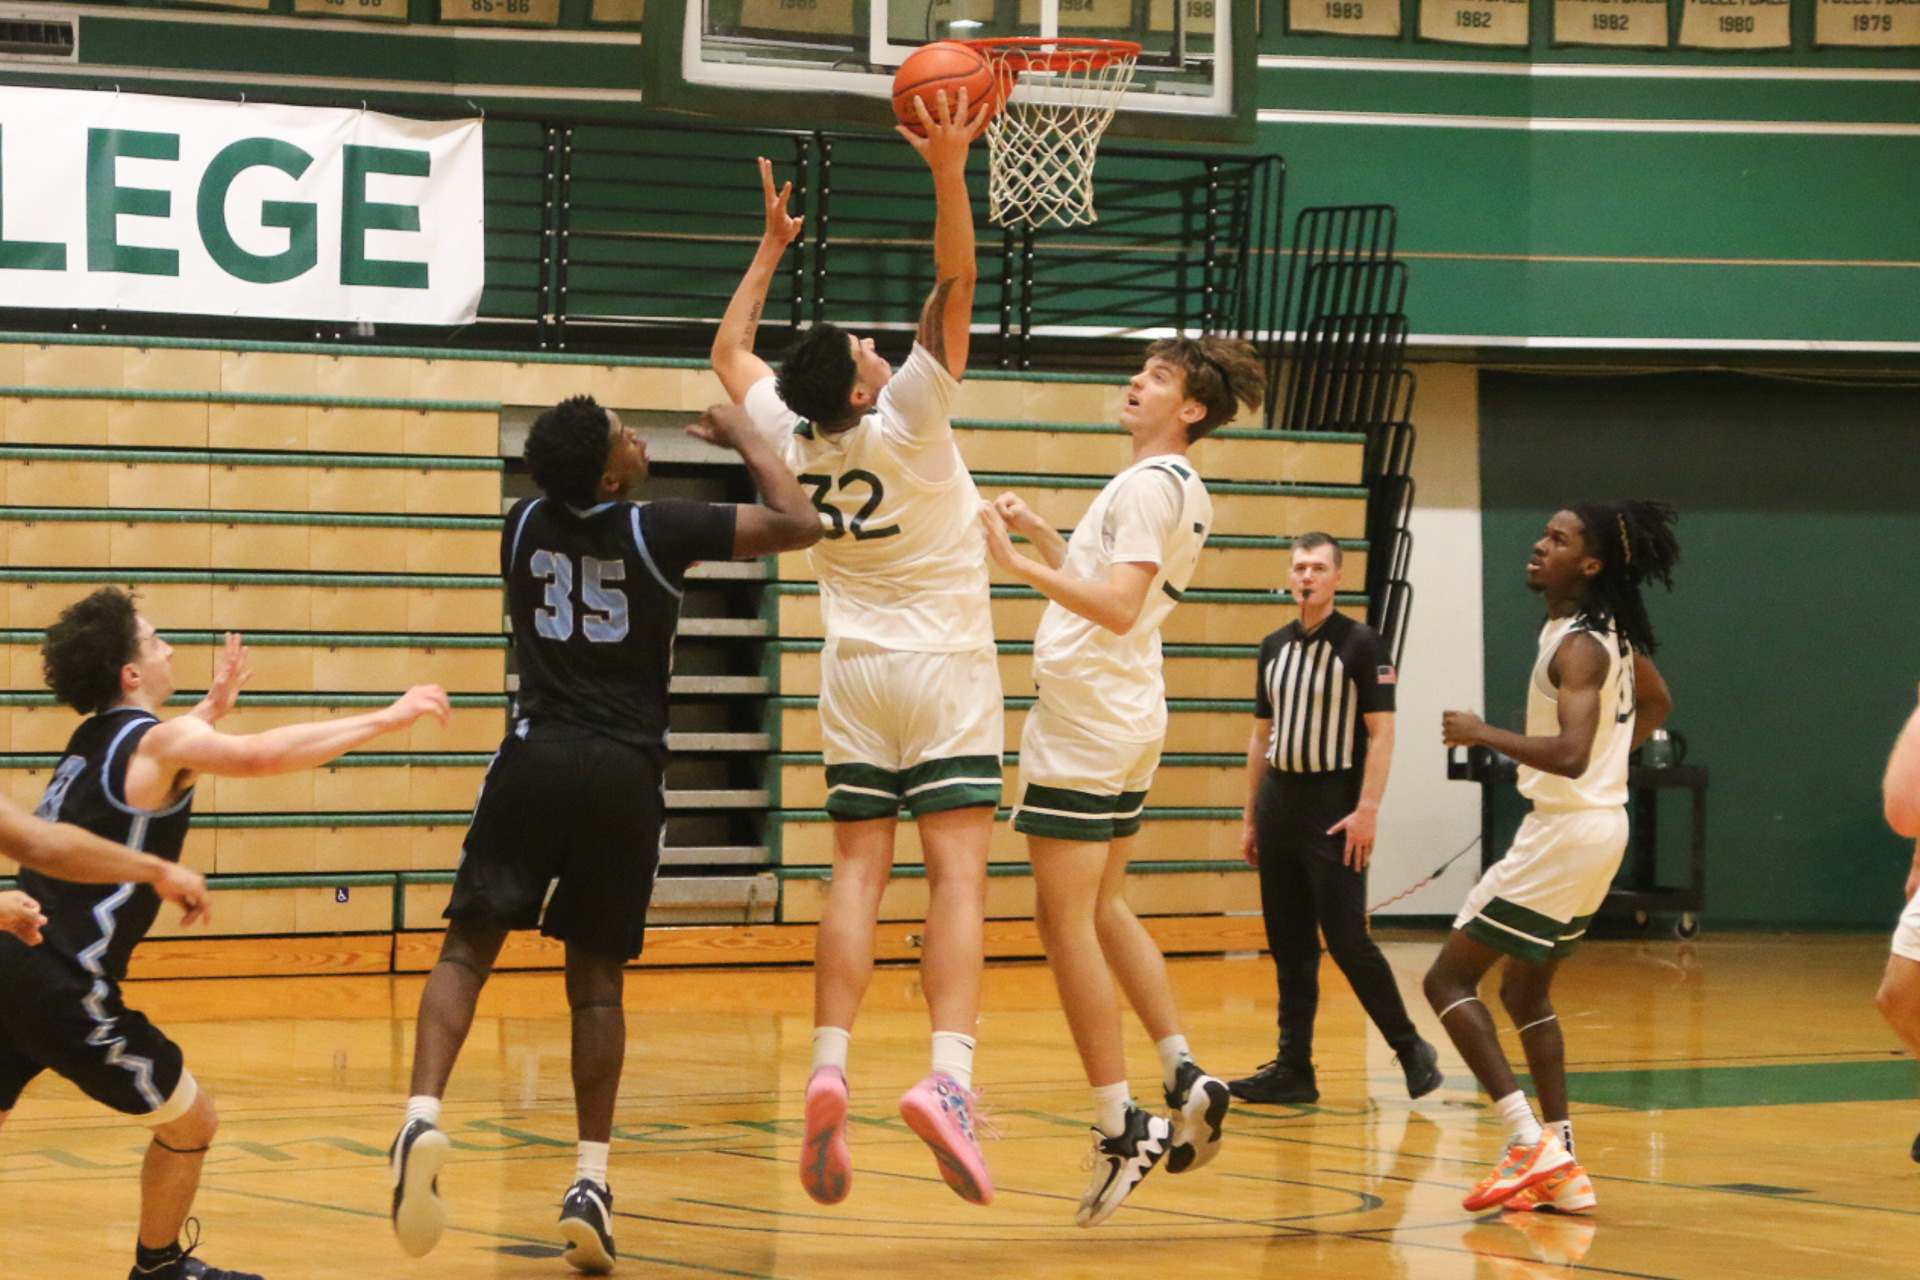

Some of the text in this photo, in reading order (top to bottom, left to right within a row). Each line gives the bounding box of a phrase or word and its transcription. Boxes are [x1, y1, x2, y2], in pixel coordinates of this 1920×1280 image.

[1187, 1, 1215, 18] 198
[1326, 1, 1363, 19] 1983
[1456, 10, 1492, 28] 1982
[1592, 13, 1629, 31] 1982
[1718, 15, 1755, 33] 1980
[1853, 14, 1892, 32] 1979
[797, 468, 901, 541] 32
[530, 549, 629, 643] 35
